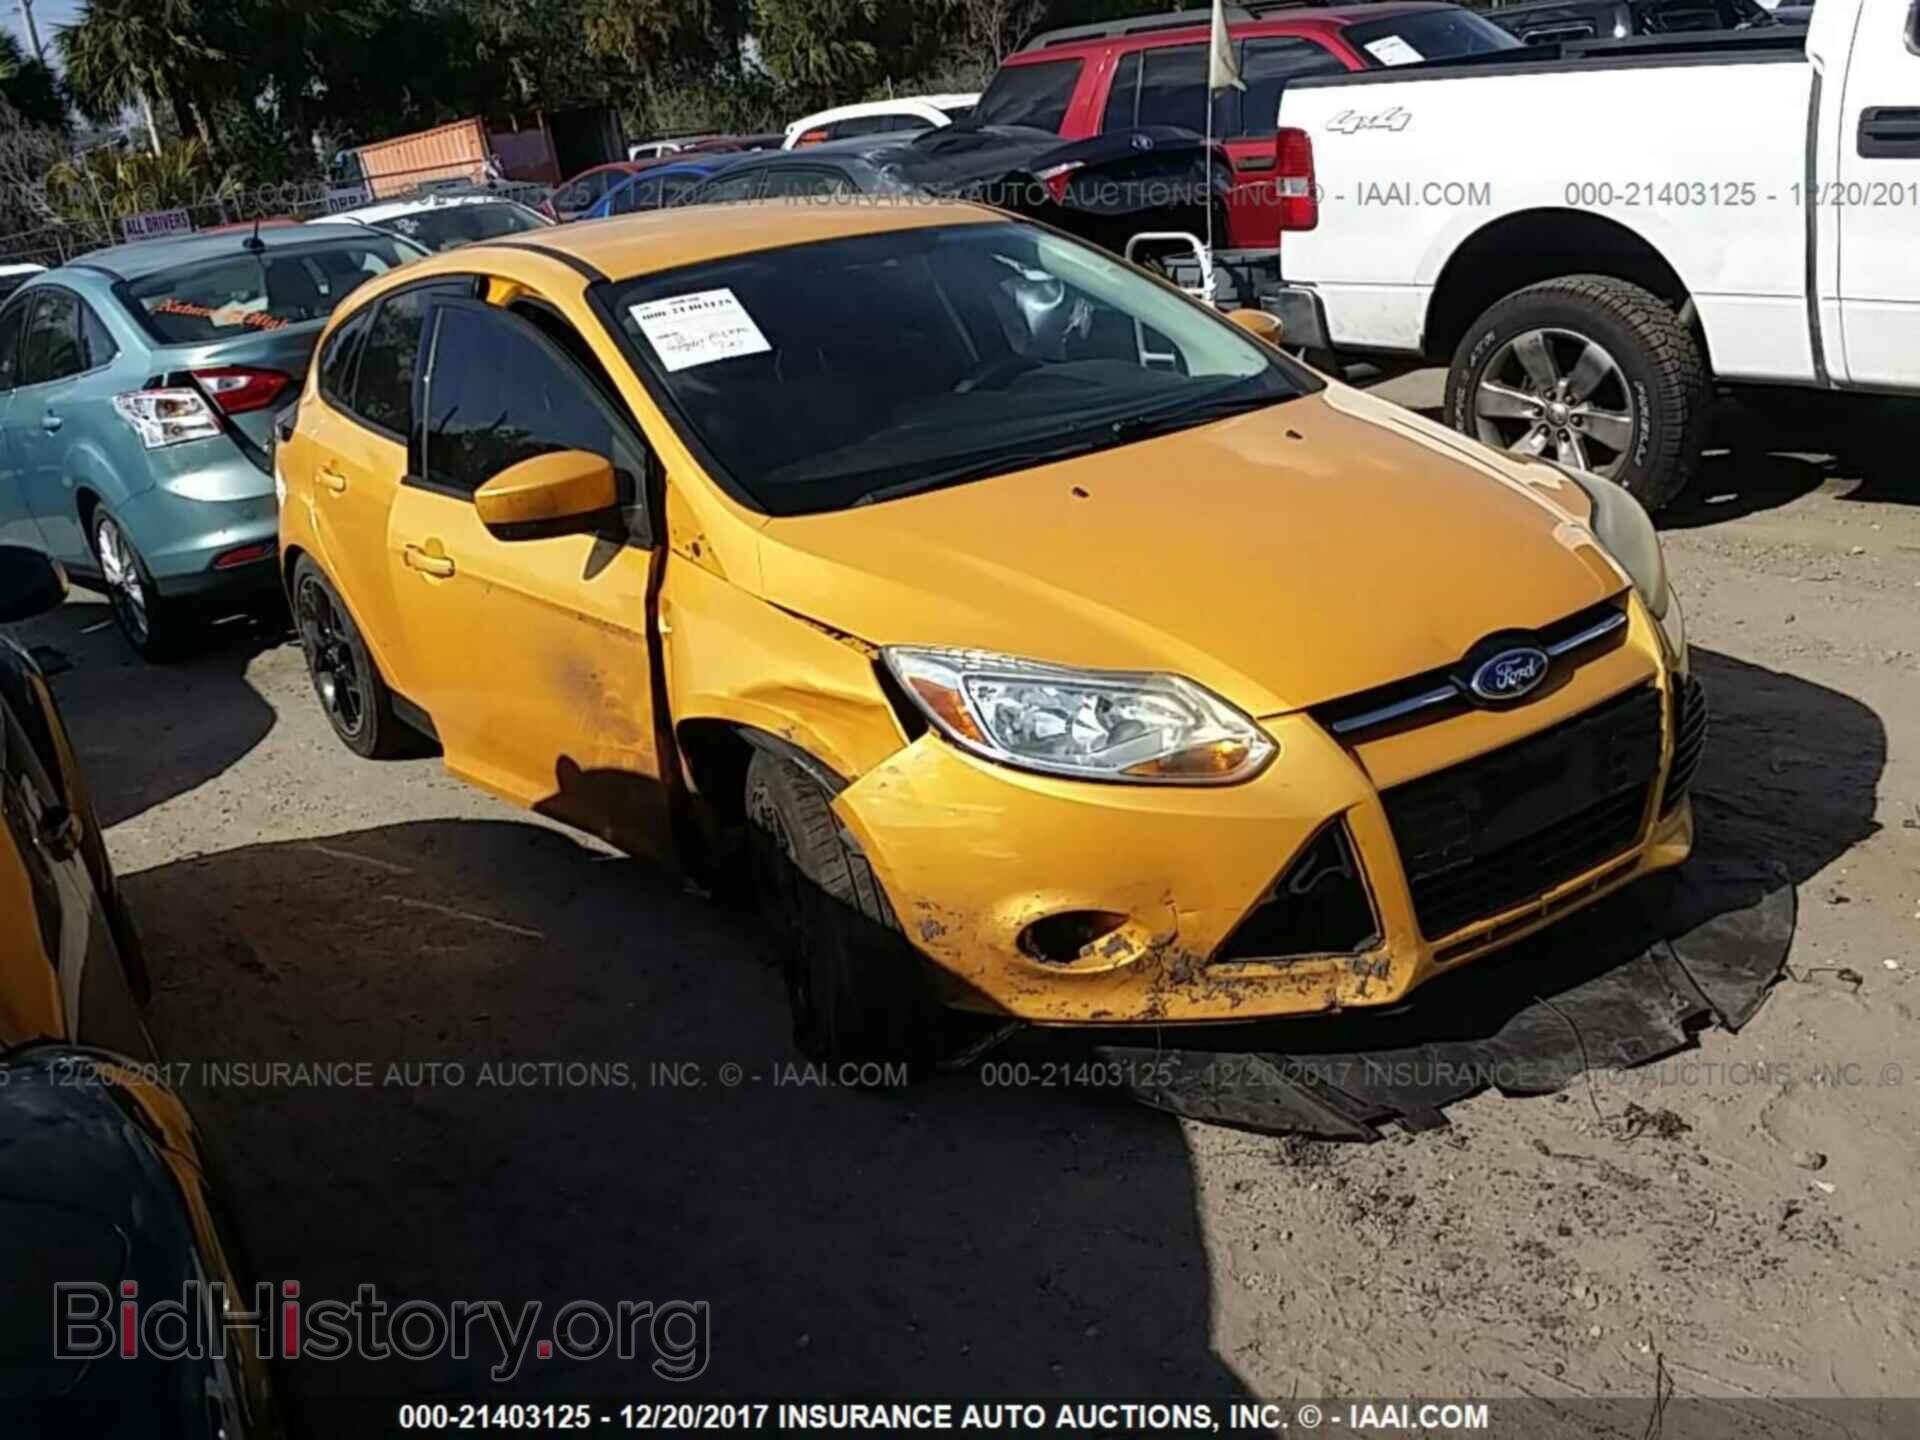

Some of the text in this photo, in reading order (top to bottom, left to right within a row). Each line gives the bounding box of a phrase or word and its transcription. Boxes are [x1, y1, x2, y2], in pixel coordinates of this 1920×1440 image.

[1326, 107, 1412, 134] 4x4
[127, 211, 189, 235] ALL DRIVERS
[1495, 656, 1536, 690] Ford
